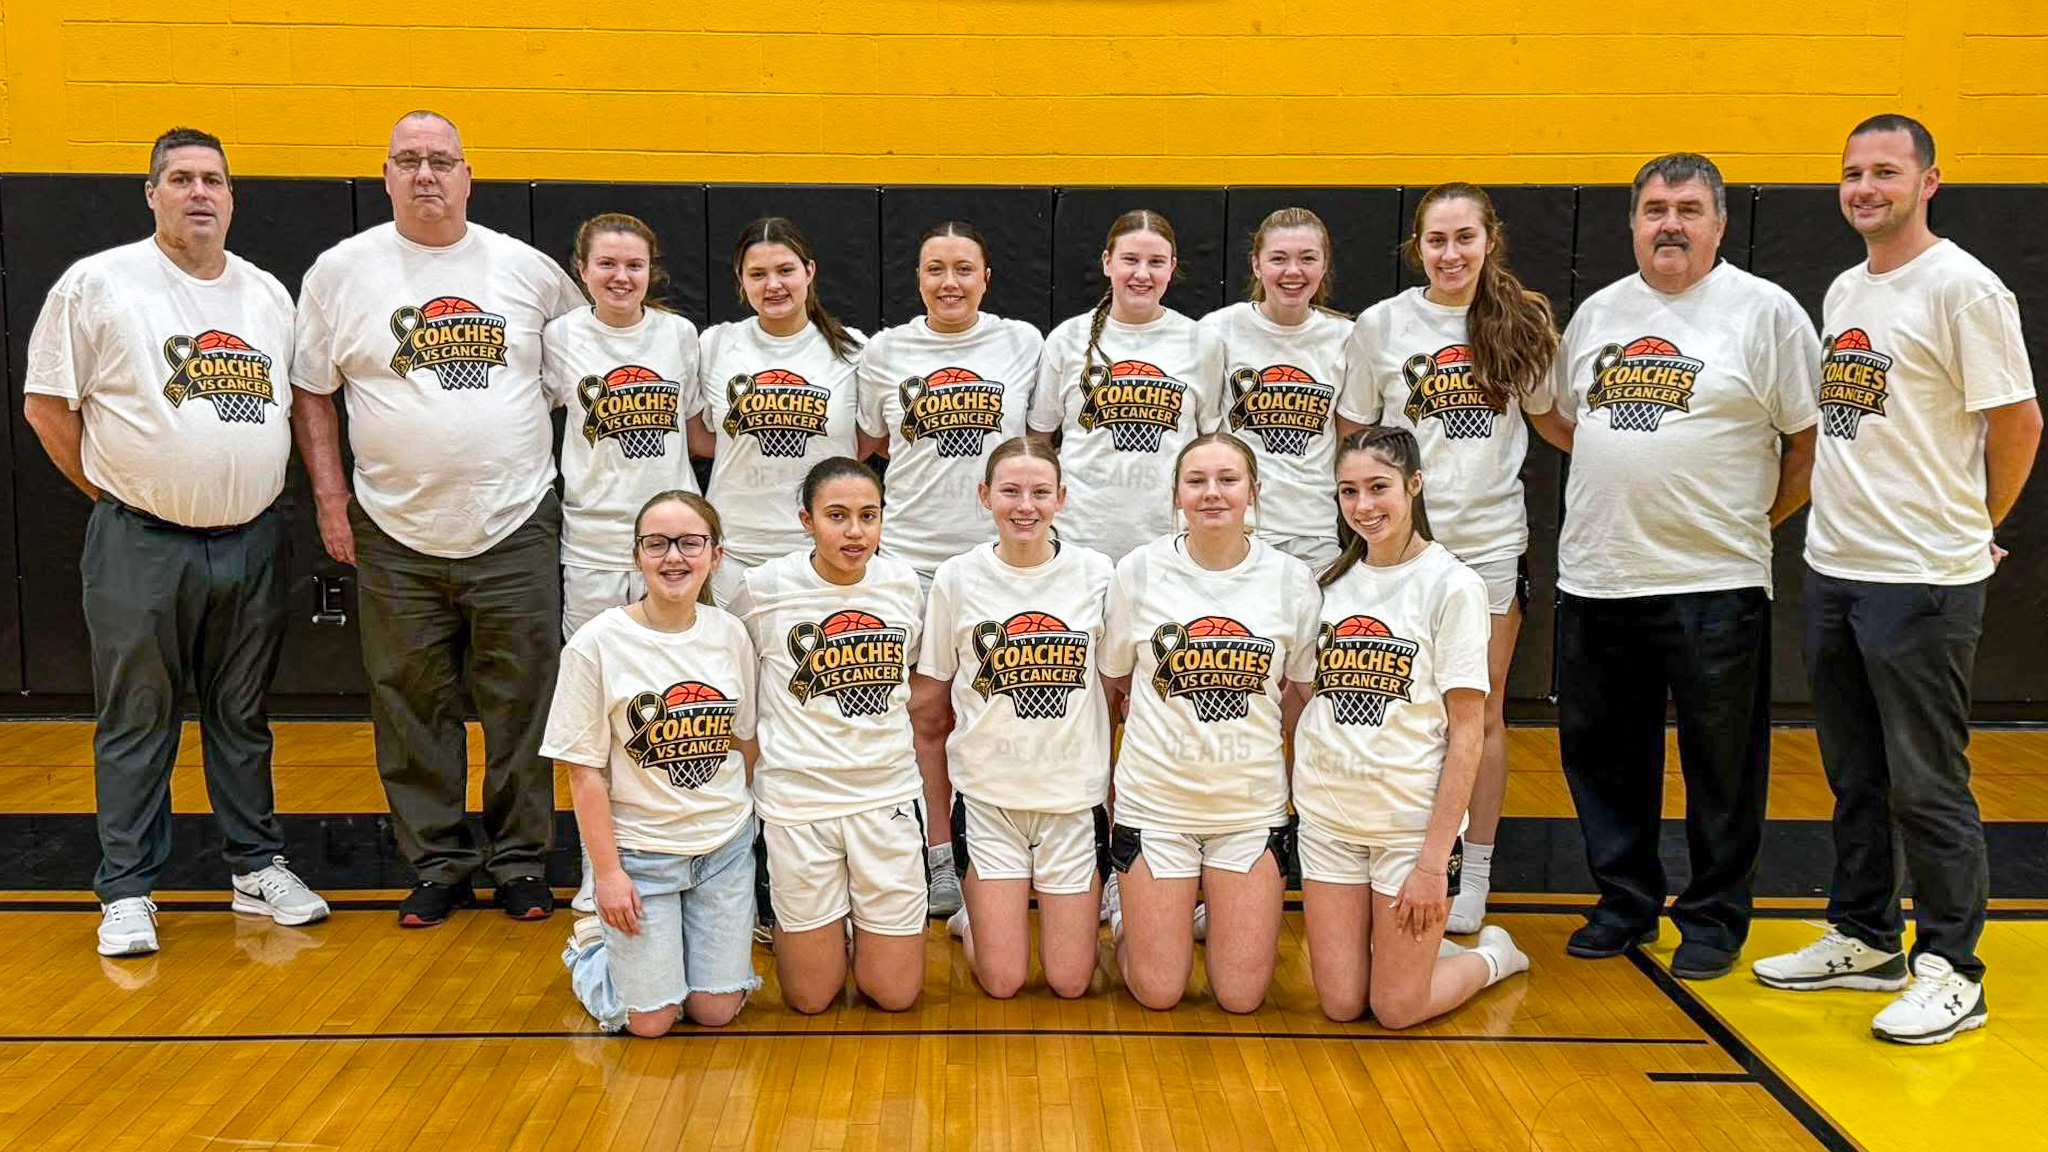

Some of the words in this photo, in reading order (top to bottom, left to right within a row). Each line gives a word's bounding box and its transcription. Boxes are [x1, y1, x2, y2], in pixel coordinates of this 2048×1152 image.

[413, 324, 504, 349] COACHES
[422, 349, 440, 361] VS
[441, 345, 498, 359] CANCER
[1423, 371, 1479, 396] COAC
[1604, 366, 1695, 389] COACHES
[1823, 362, 1885, 391] COACHES
[198, 380, 216, 391] VS
[217, 380, 270, 395] CANCER
[1096, 385, 1182, 411] COACHES
[1606, 388, 1622, 399] VS
[1624, 387, 1680, 403] CANCER
[597, 393, 678, 418] COACHES
[741, 394, 826, 416] COACHES
[916, 391, 1001, 417] COACHES
[1247, 391, 1329, 416] COACHES
[1431, 396, 1448, 409] VS
[1449, 393, 1486, 405] CANC
[605, 417, 622, 430] VS
[623, 414, 673, 426] CANCER
[747, 415, 763, 427] VS
[764, 414, 818, 429] CANCER
[923, 418, 939, 430] VS
[940, 413, 994, 426] CANCER
[1102, 406, 1118, 419] VS
[1120, 407, 1173, 424] CANCER
[1252, 413, 1269, 424] VS
[1270, 413, 1320, 429] CANCER
[812, 642, 904, 672] COACHES
[993, 645, 1086, 670] COACHES
[1171, 649, 1270, 674] COACHES
[1320, 648, 1412, 677] COACHES
[821, 672, 840, 687] VS
[842, 666, 899, 682] CANCER
[999, 671, 1018, 686] VS
[1020, 669, 1078, 682] CANCER
[1180, 674, 1198, 689] VS
[1200, 673, 1260, 689] CANCER
[1323, 674, 1340, 687] VS
[1341, 674, 1401, 693] CANCER
[650, 715, 732, 744] COACHE
[656, 744, 676, 759] VS
[678, 739, 730, 755] CANCER
